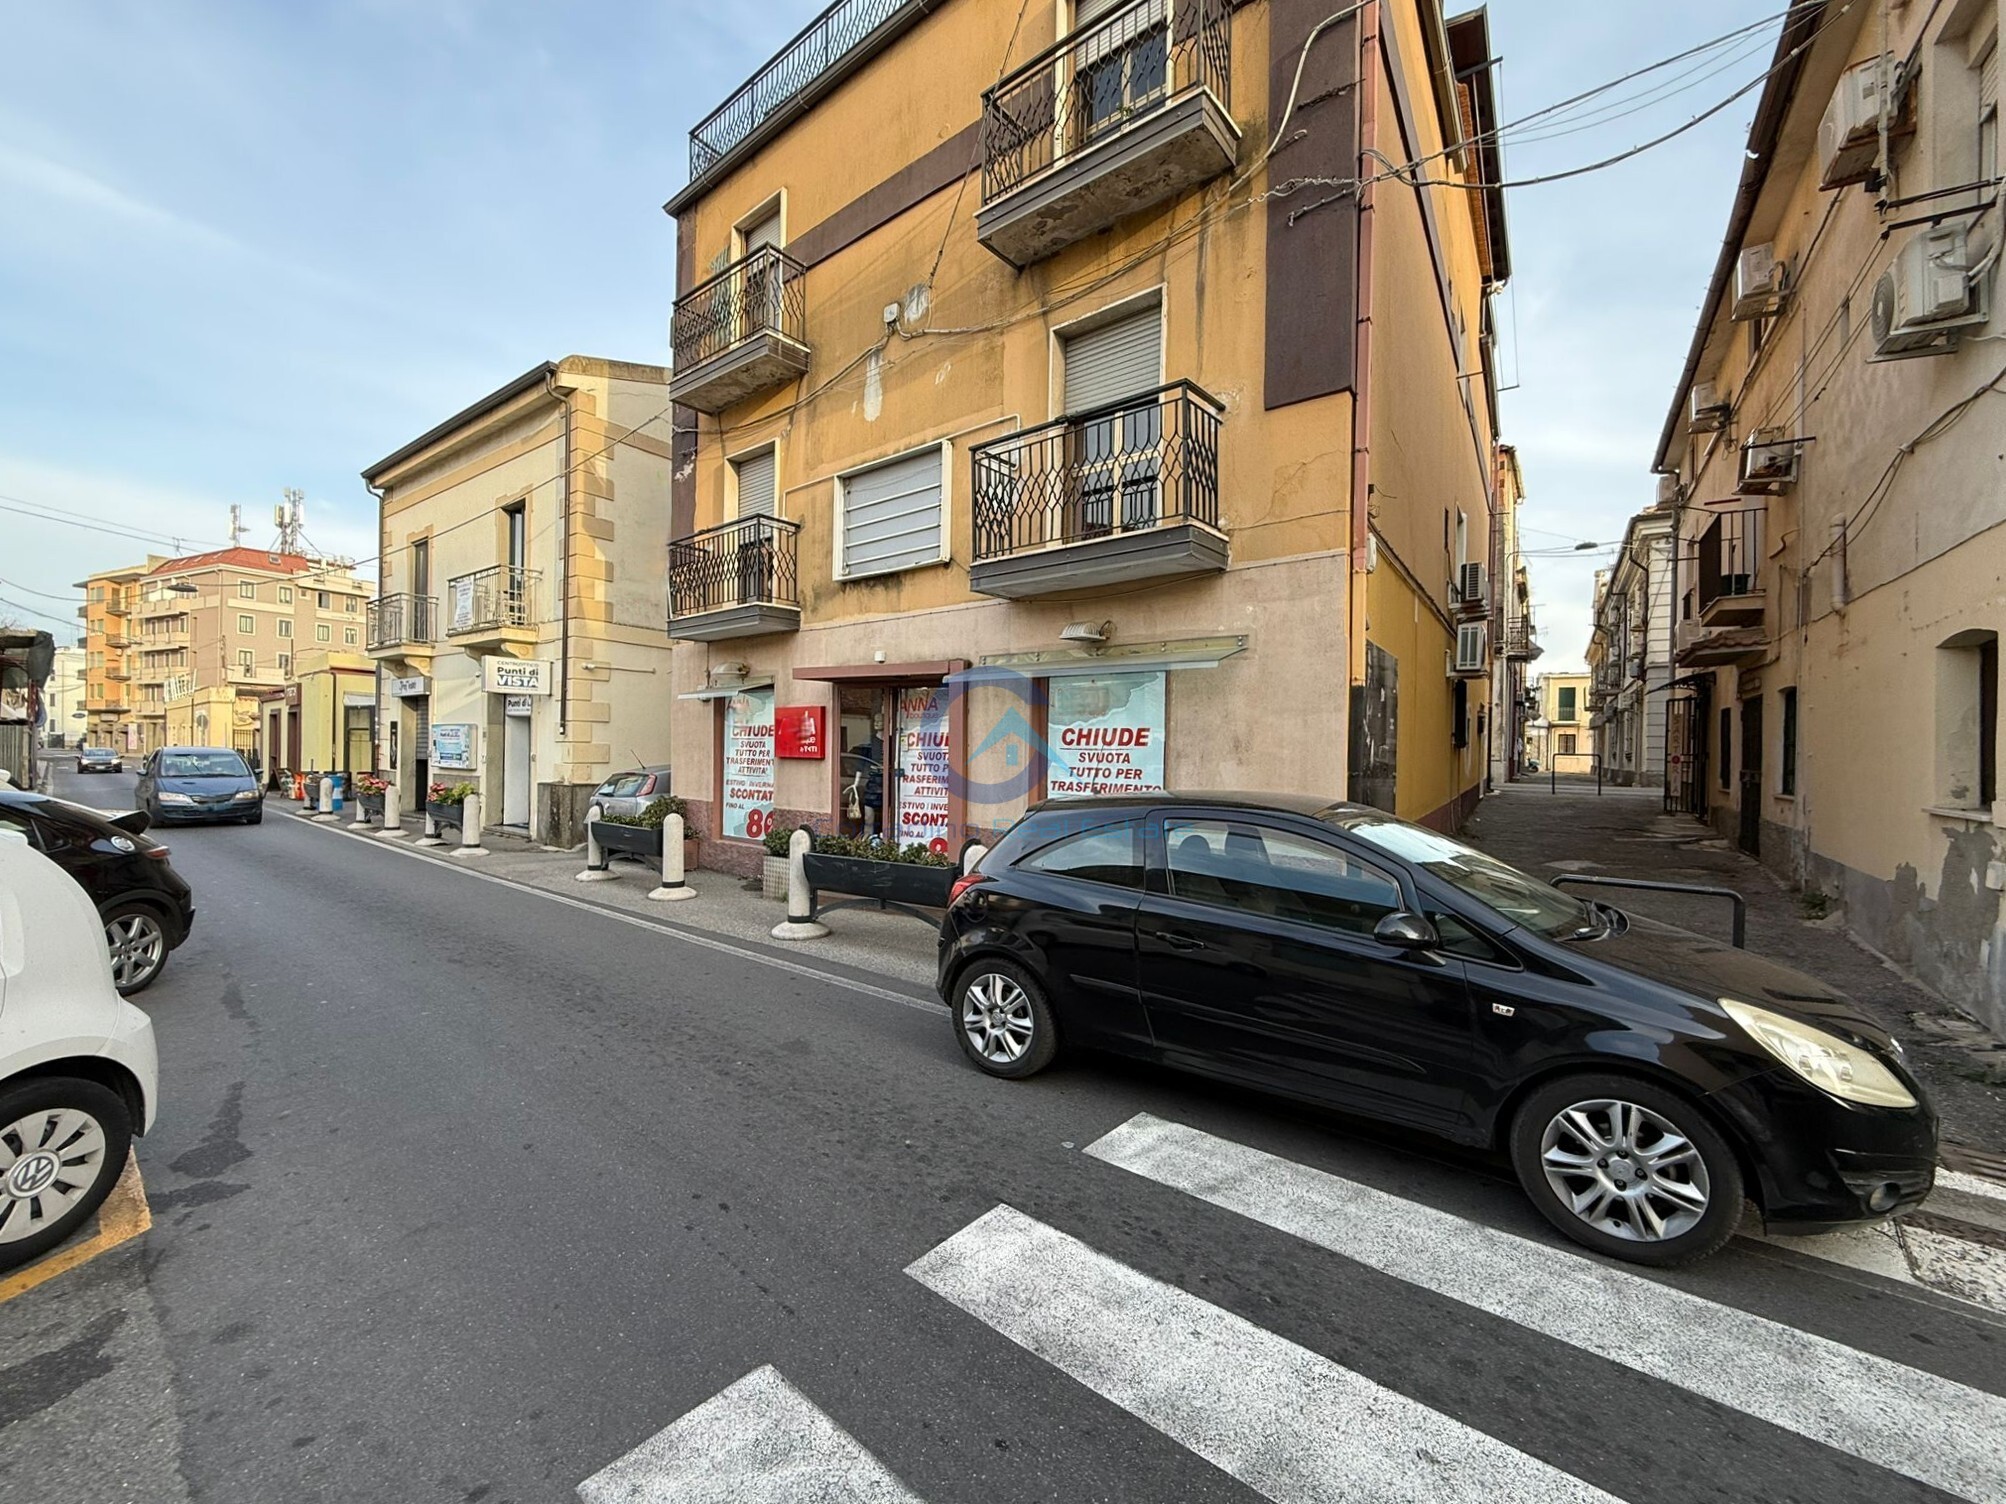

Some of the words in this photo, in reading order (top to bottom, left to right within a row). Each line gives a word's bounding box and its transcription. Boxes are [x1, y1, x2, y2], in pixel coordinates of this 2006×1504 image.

[497, 667, 526, 675] Punti
[529, 668, 539, 676] di
[497, 675, 539, 688] VISTA
[732, 725, 774, 737] CHIUDE
[1061, 727, 1150, 747] CHIUDE
[740, 740, 766, 749] SVUOTA
[735, 749, 757, 757] TUTTO
[758, 749, 770, 757] PER
[917, 752, 949, 761] SVUOT
[1078, 752, 1131, 764] SVUOTA
[911, 764, 939, 773] TUTTO
[1068, 767, 1111, 779] TUTTO
[1115, 768, 1143, 780] PER
[902, 811, 949, 828] SCONT
